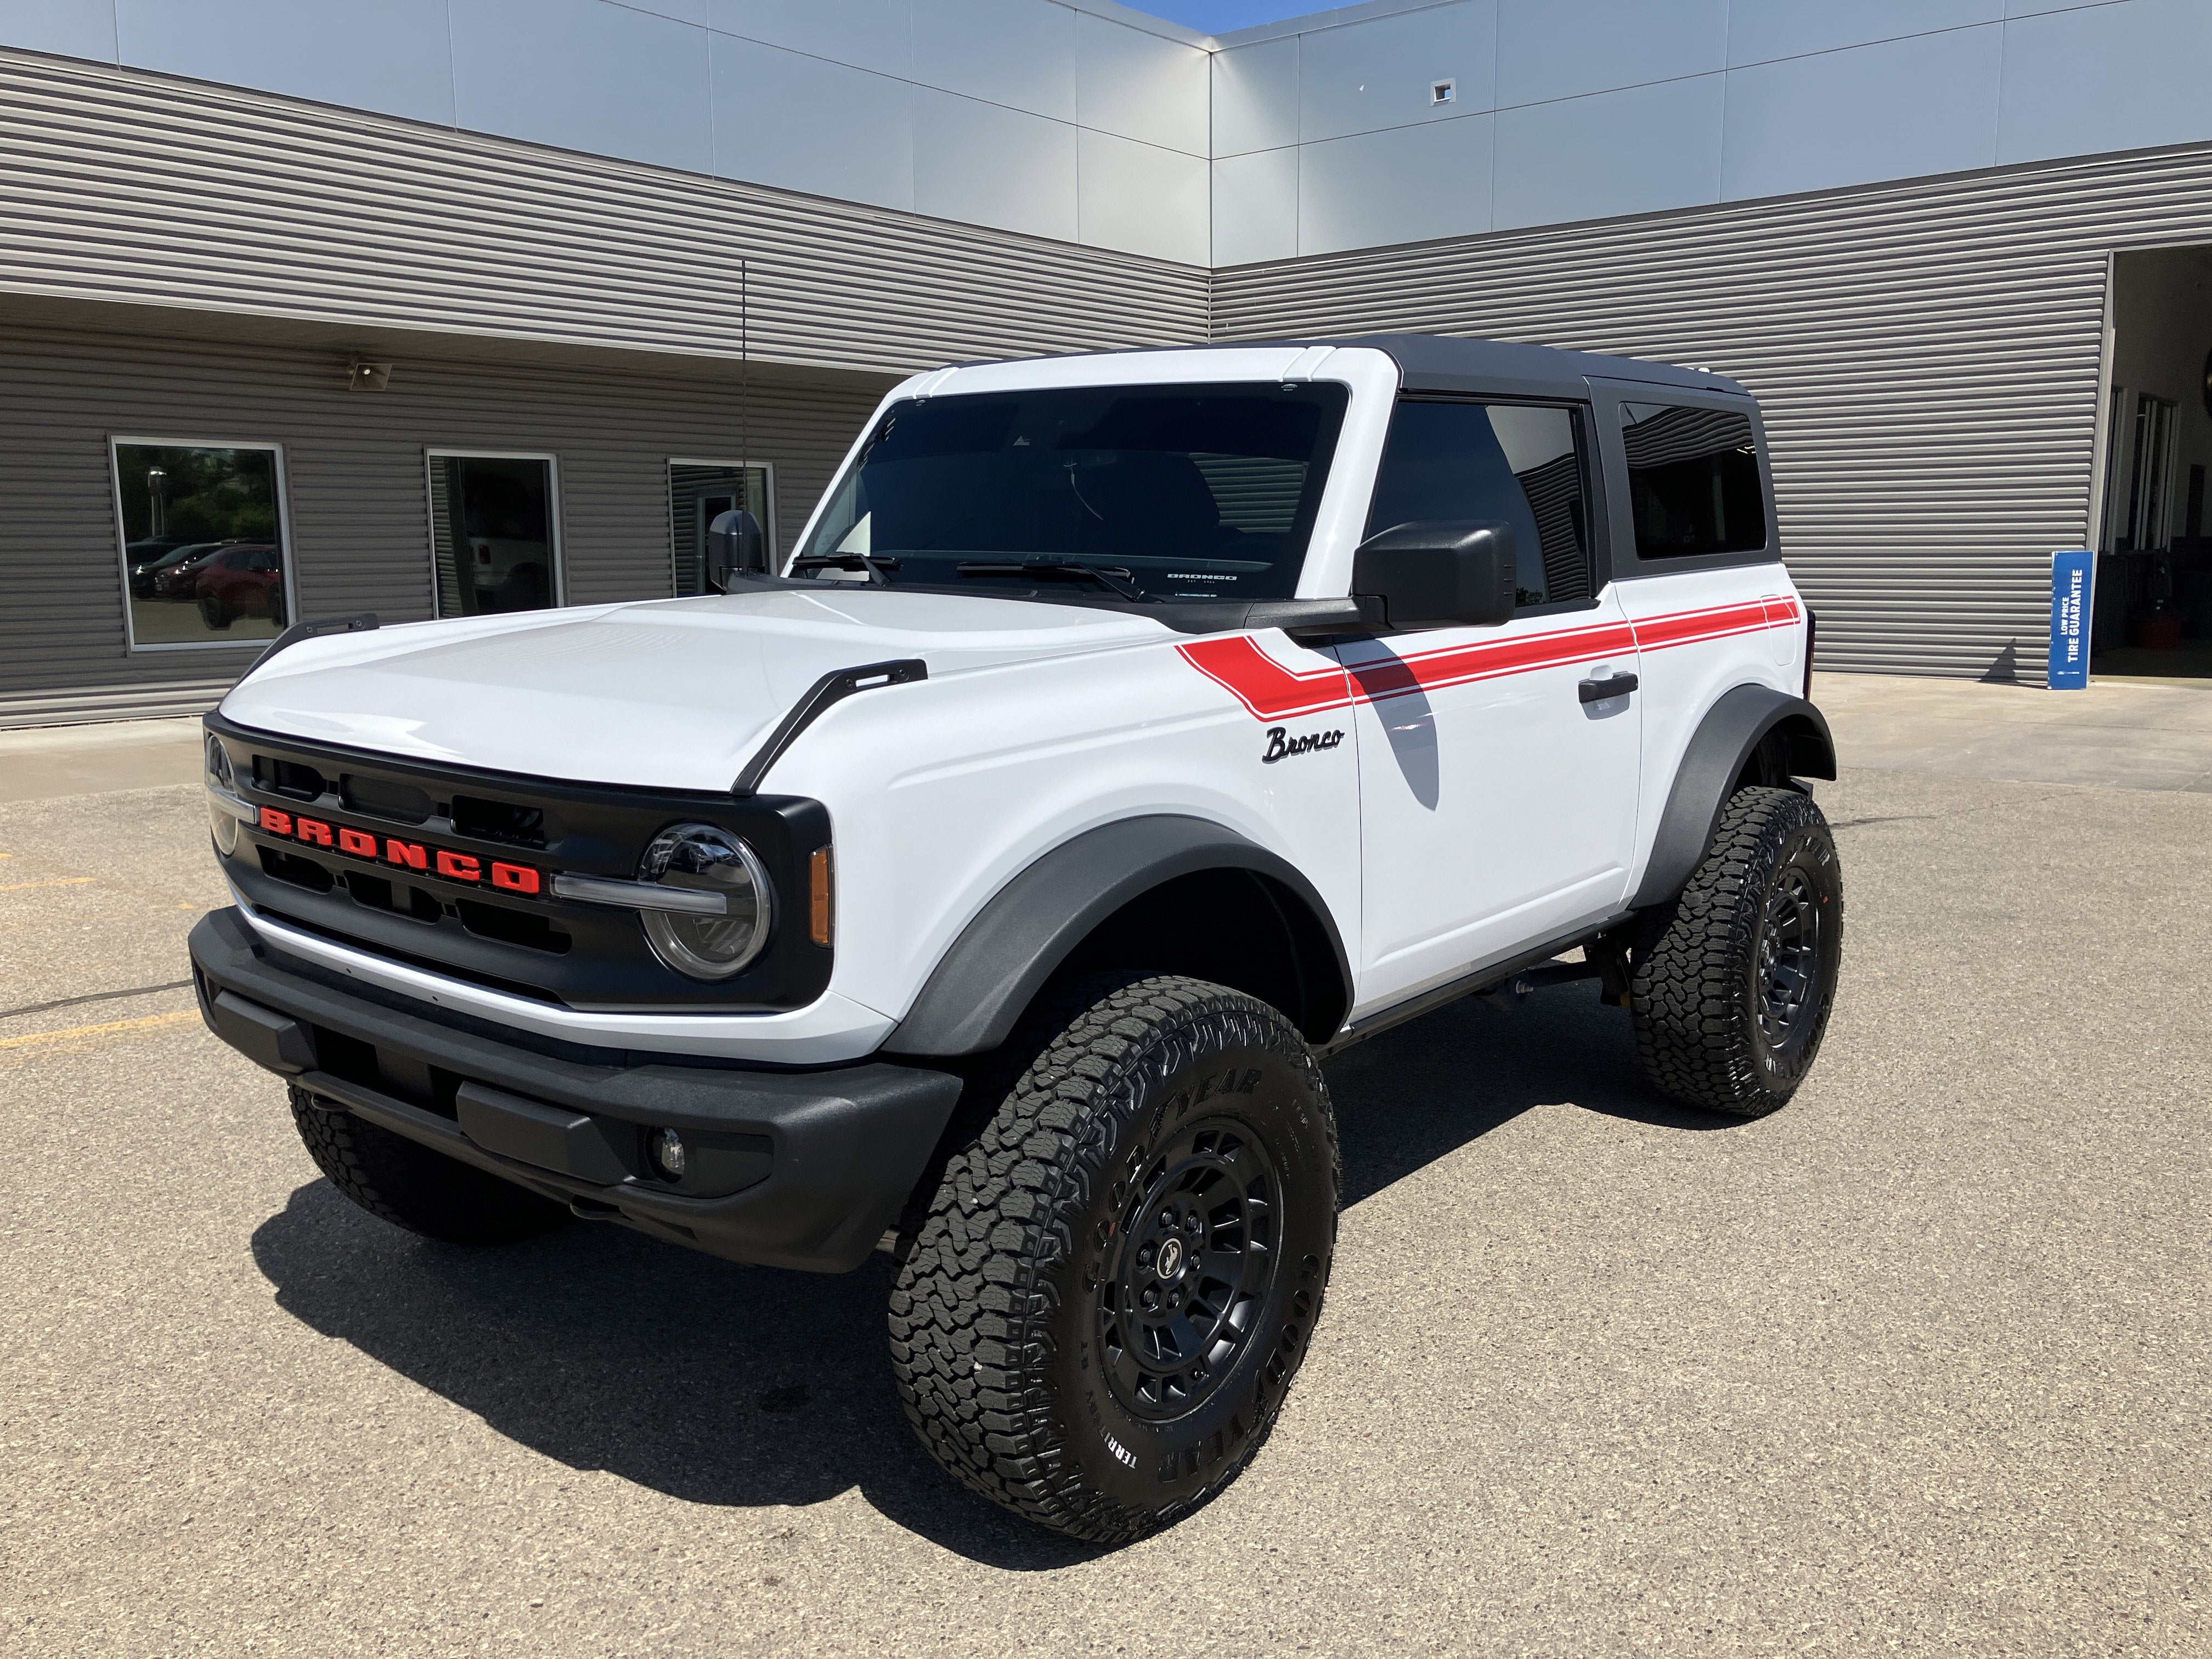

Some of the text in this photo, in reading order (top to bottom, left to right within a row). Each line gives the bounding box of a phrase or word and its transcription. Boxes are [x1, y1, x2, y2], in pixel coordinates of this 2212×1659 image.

[2061, 596, 2069, 635] LOW PRICE
[2068, 569, 2083, 663] TIRE GUARANTEE
[1262, 726, 1345, 764] Bronco
[259, 806, 540, 894] BRONCO
